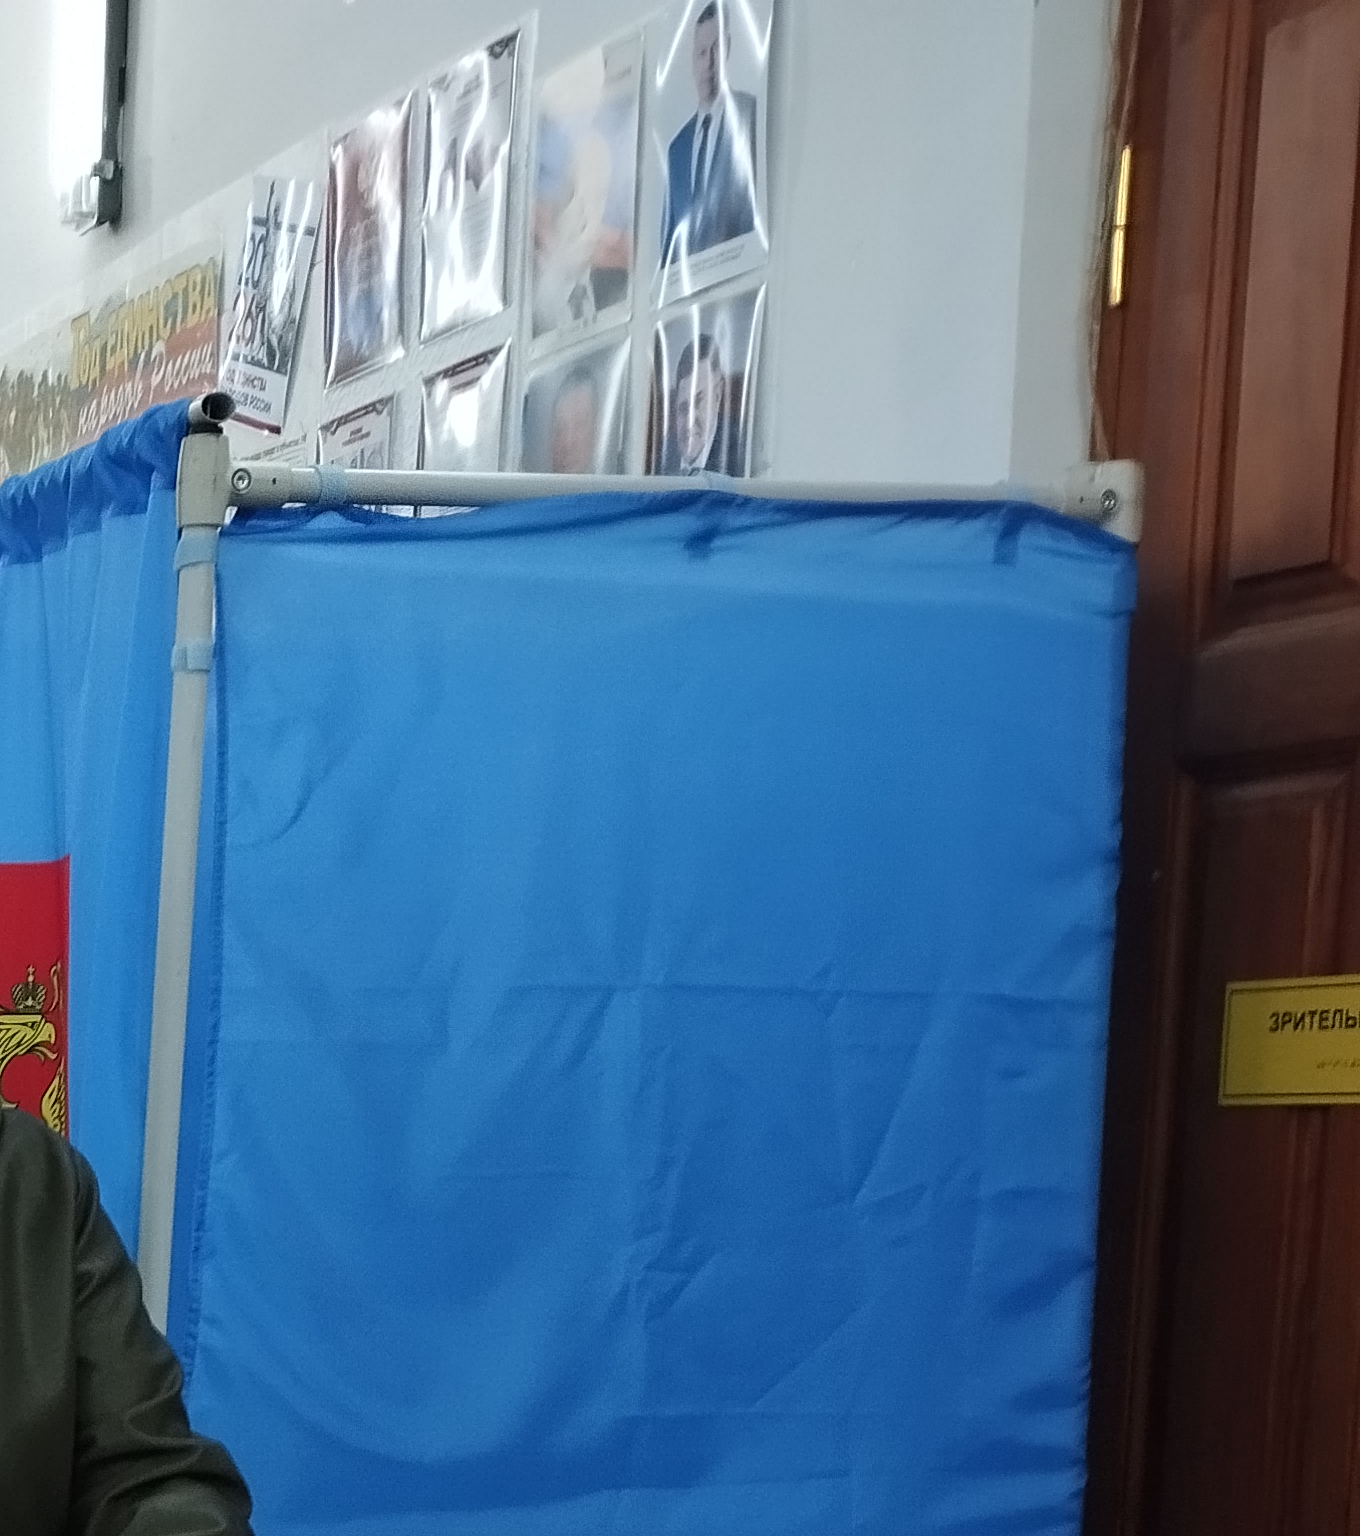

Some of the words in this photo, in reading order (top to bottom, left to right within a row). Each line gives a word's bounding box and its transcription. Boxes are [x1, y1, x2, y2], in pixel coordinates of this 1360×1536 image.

[107, 256, 217, 377] ЕДИНСТВА
[149, 339, 214, 405] России
[1268, 1008, 1360, 1033] ЗРИТЕЛЬ
